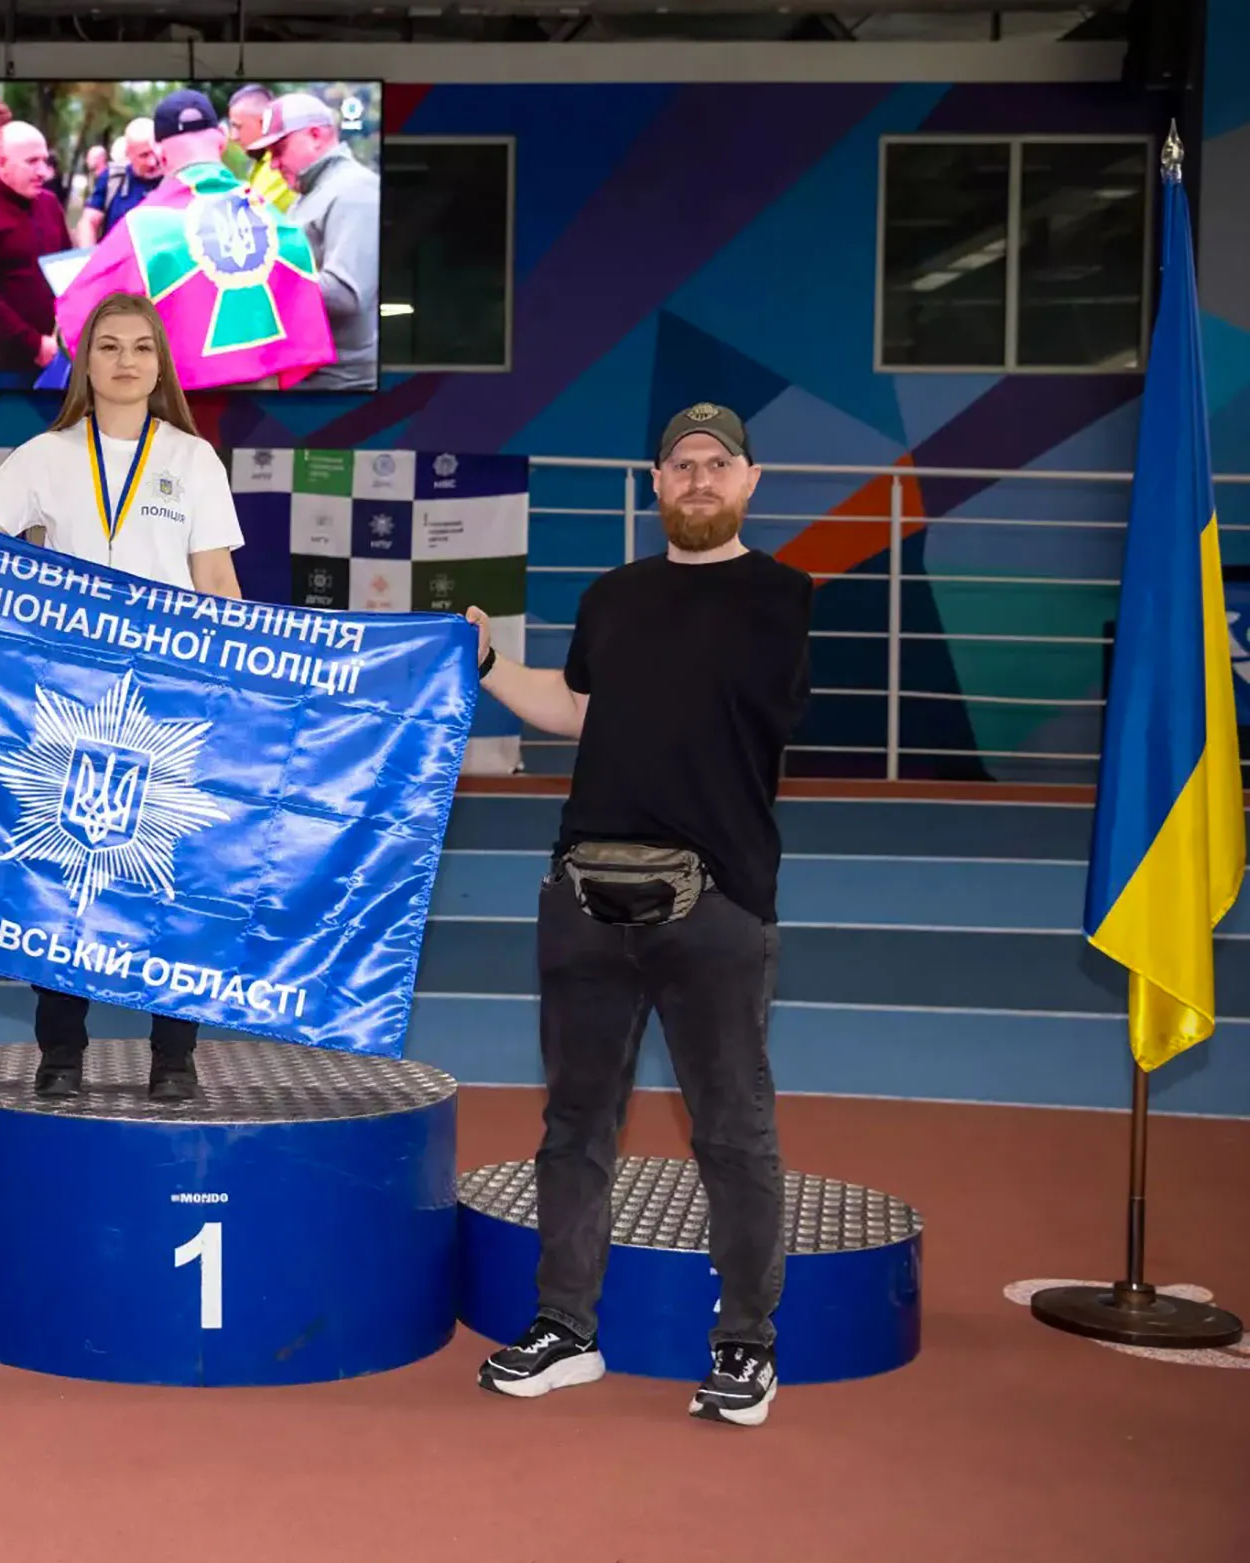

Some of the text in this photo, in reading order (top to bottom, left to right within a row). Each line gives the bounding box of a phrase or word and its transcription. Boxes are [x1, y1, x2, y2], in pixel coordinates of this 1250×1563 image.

[141, 505, 186, 524] ПОЛІЦІЯ
[125, 584, 366, 653] УПРАВЛІННЯ
[219, 639, 365, 696] ПОЛІЦІЇ
[141, 957, 307, 1018] ОБЛАСТІ
[179, 1192, 229, 1203] MONDO
[174, 1222, 222, 1329] 1
